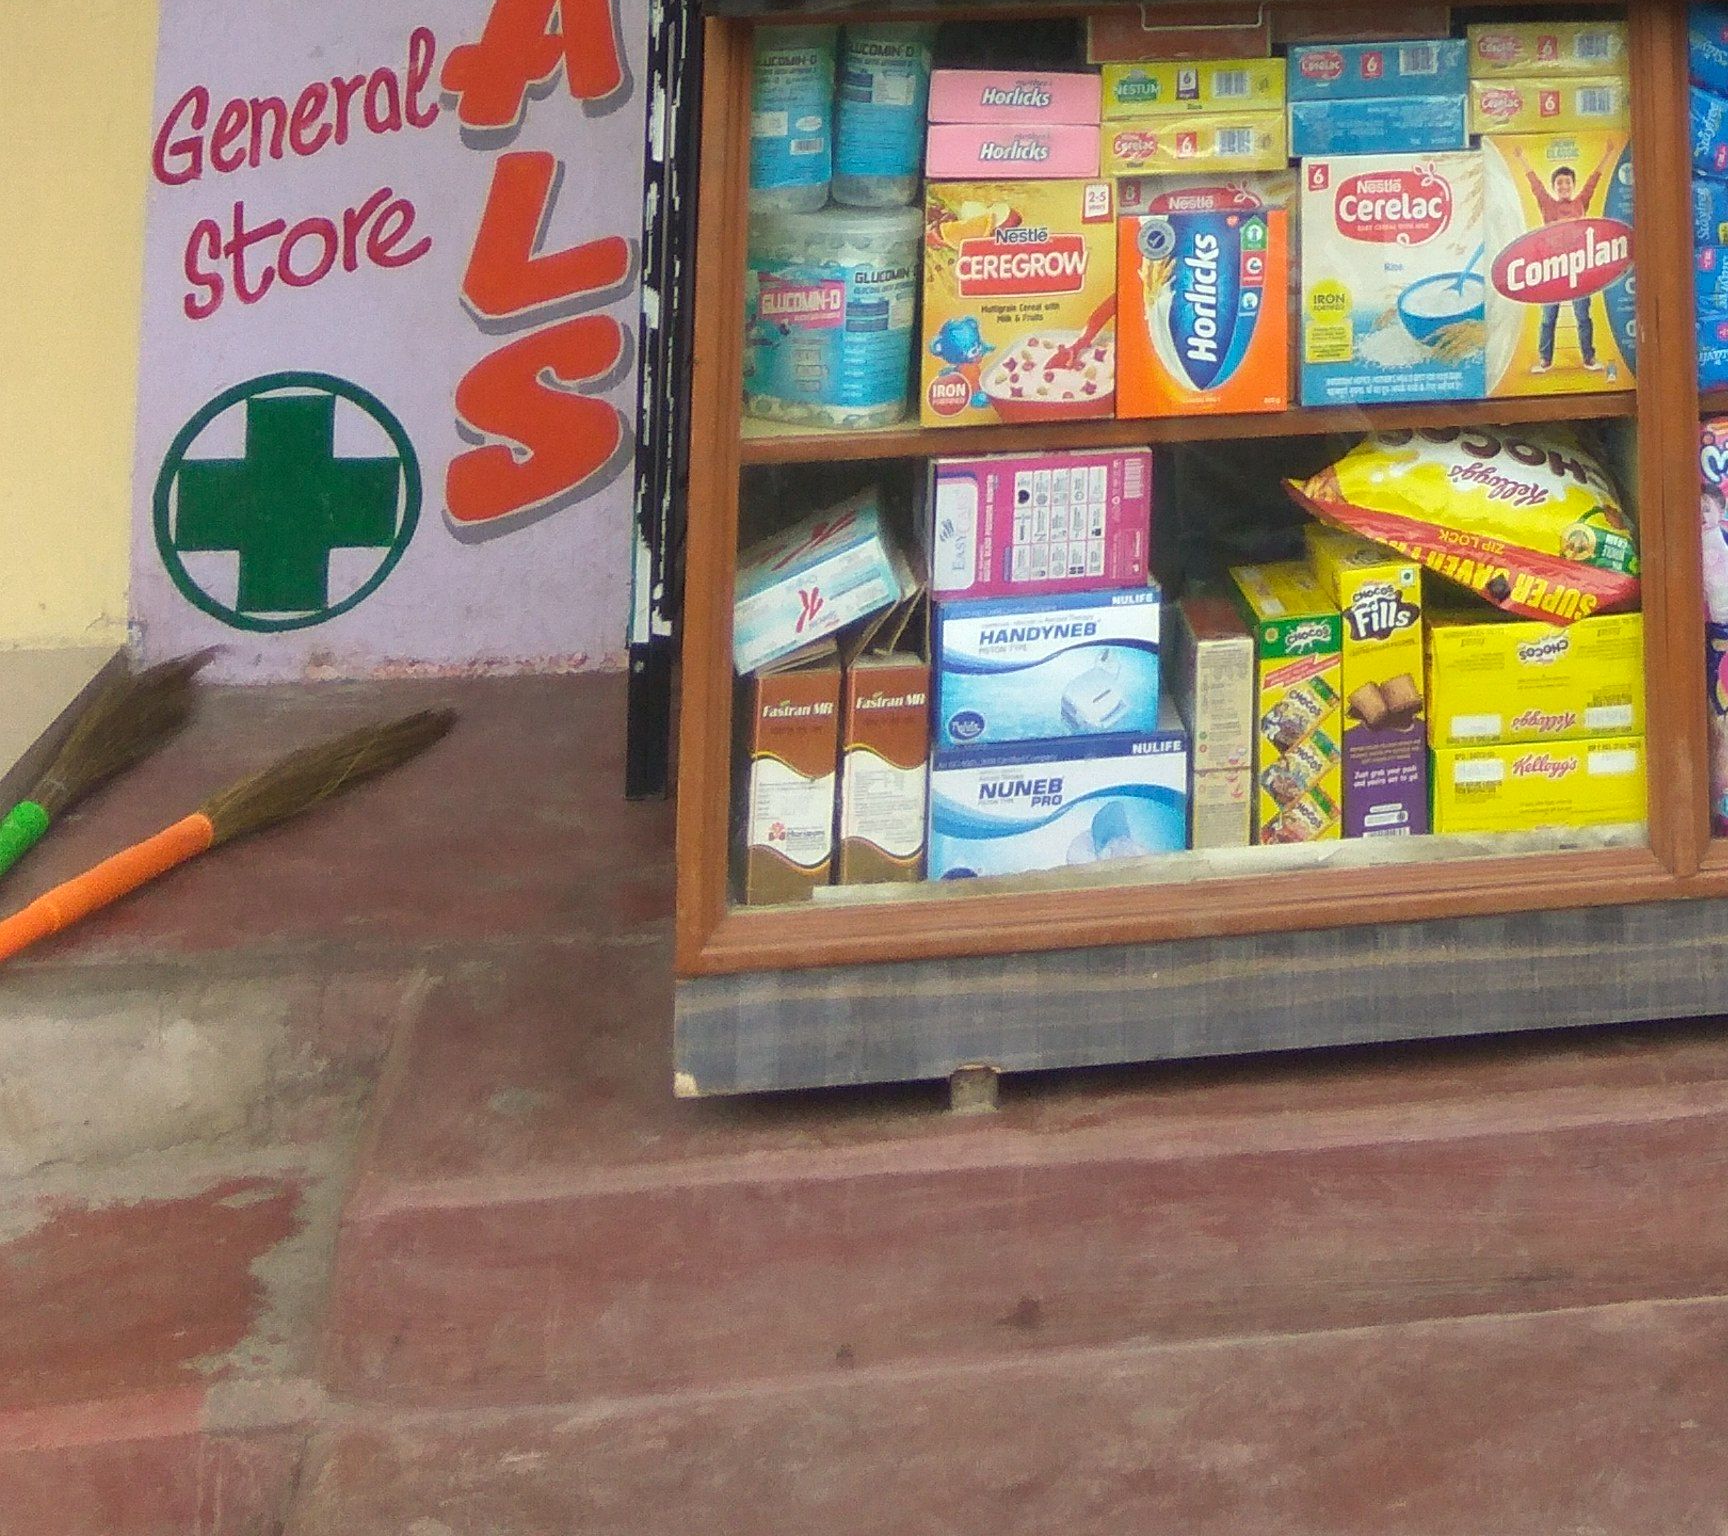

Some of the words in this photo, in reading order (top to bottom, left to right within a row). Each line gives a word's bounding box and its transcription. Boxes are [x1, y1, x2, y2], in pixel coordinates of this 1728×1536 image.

[152, 26, 441, 186] General
[981, 86, 1051, 107] Horlicks
[979, 141, 1050, 162] Horlicks
[1313, 168, 1324, 184] 6
[1339, 193, 1443, 222] Cerelac
[955, 251, 1088, 280] CEREGROW
[1506, 227, 1629, 293] Complan
[1184, 233, 1219, 363] Horlicks
[1313, 292, 1345, 305] IRON
[932, 384, 966, 398] IRON
[1111, 593, 1153, 606] NULIFE
[1510, 572, 1598, 620] SUPER
[1354, 599, 1412, 638] Fills
[978, 621, 1098, 646] HANDYNEB
[1132, 740, 1182, 755] NULIFE
[1513, 754, 1578, 778] Kellogg's
[978, 778, 1064, 800] NUNEB
[1030, 794, 1063, 808] PRO
